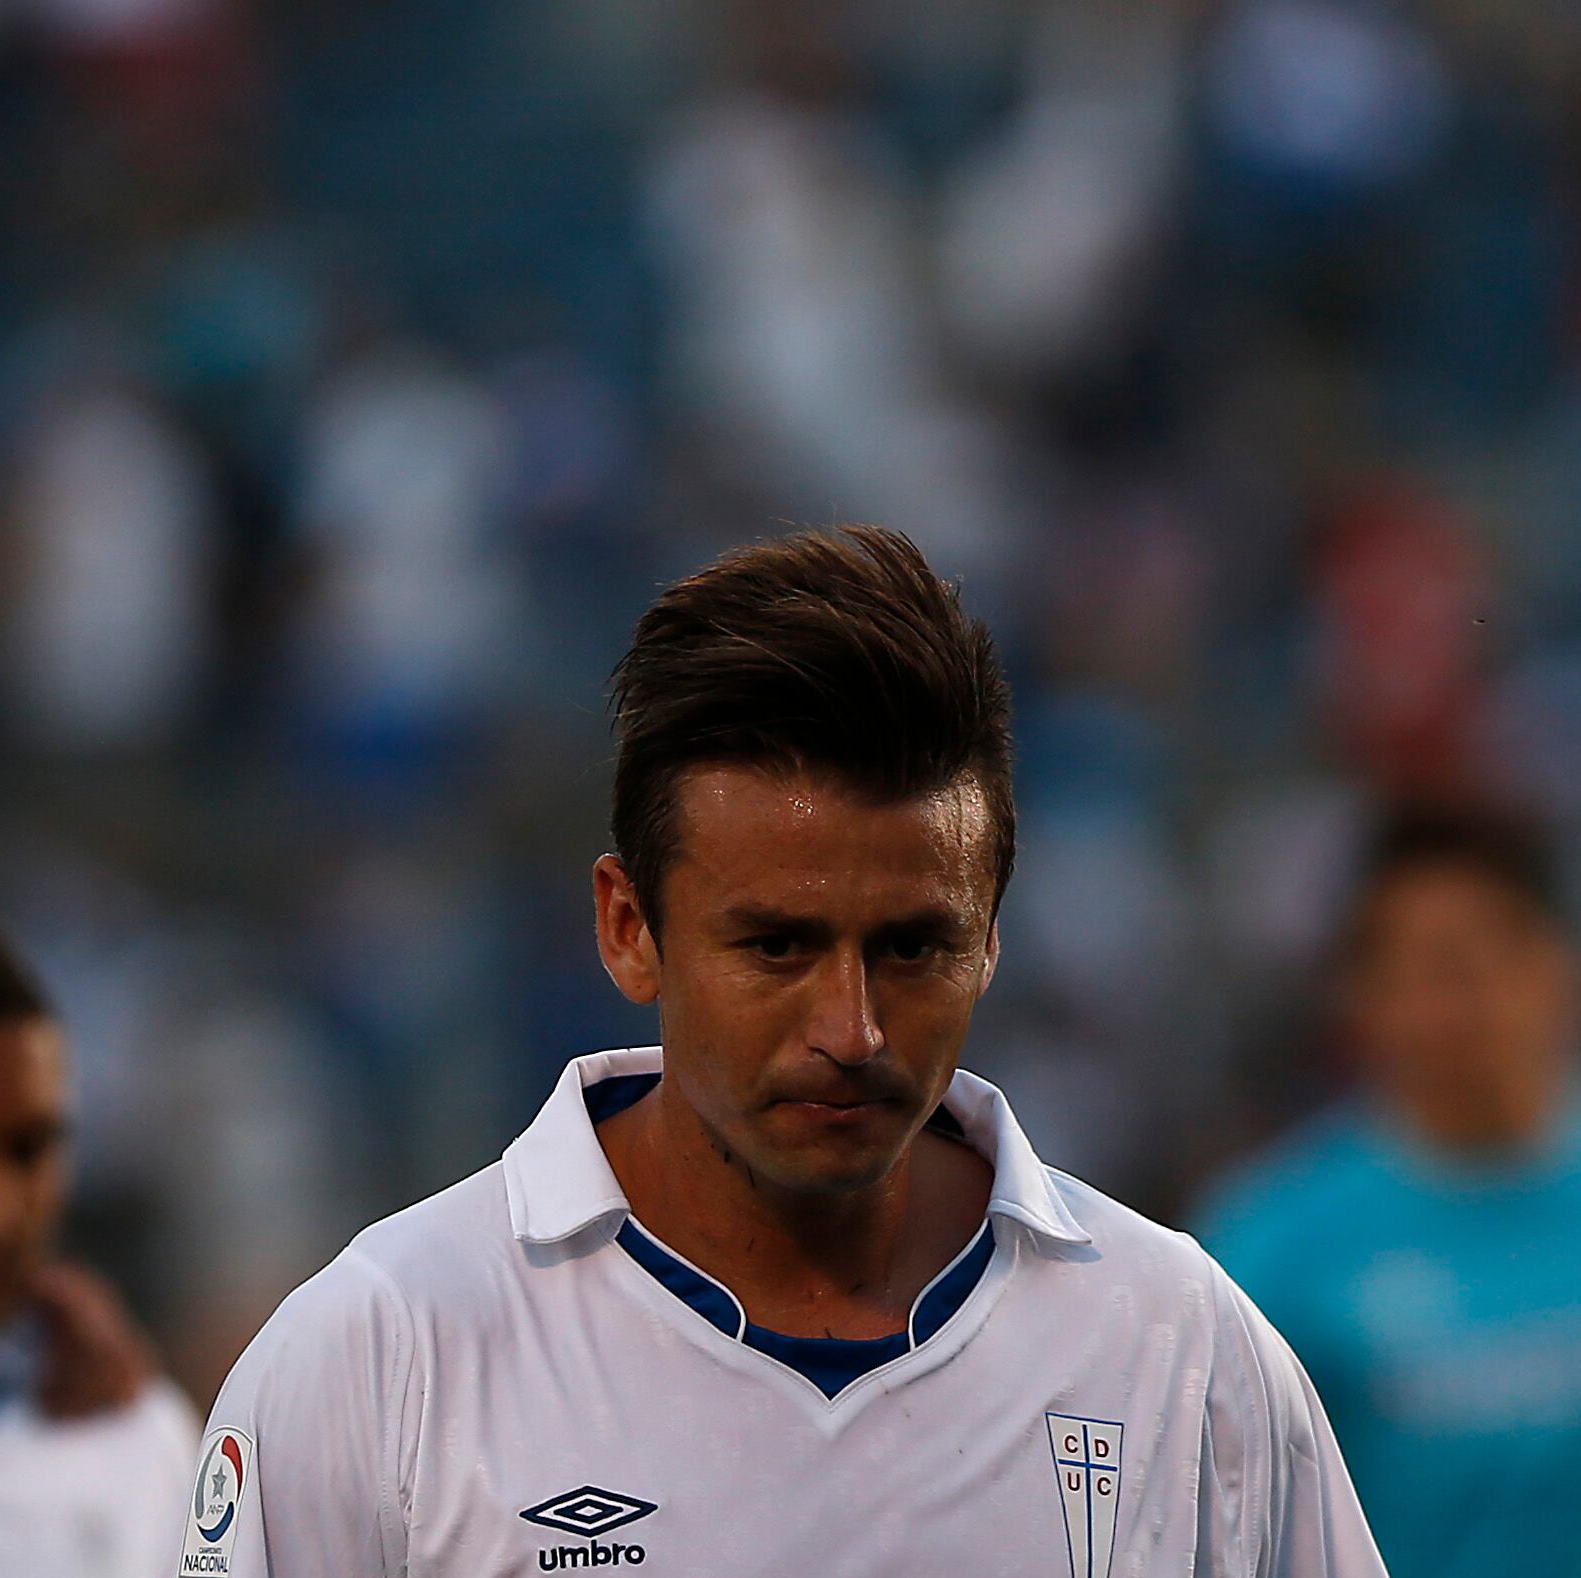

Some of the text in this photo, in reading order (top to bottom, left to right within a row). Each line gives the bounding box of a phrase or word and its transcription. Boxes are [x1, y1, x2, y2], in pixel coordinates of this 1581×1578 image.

[1064, 1434, 1110, 1458] C D
[1067, 1471, 1112, 1496] U C
[183, 1554, 229, 1573] NACIONAL
[538, 1539, 646, 1572] umbro
